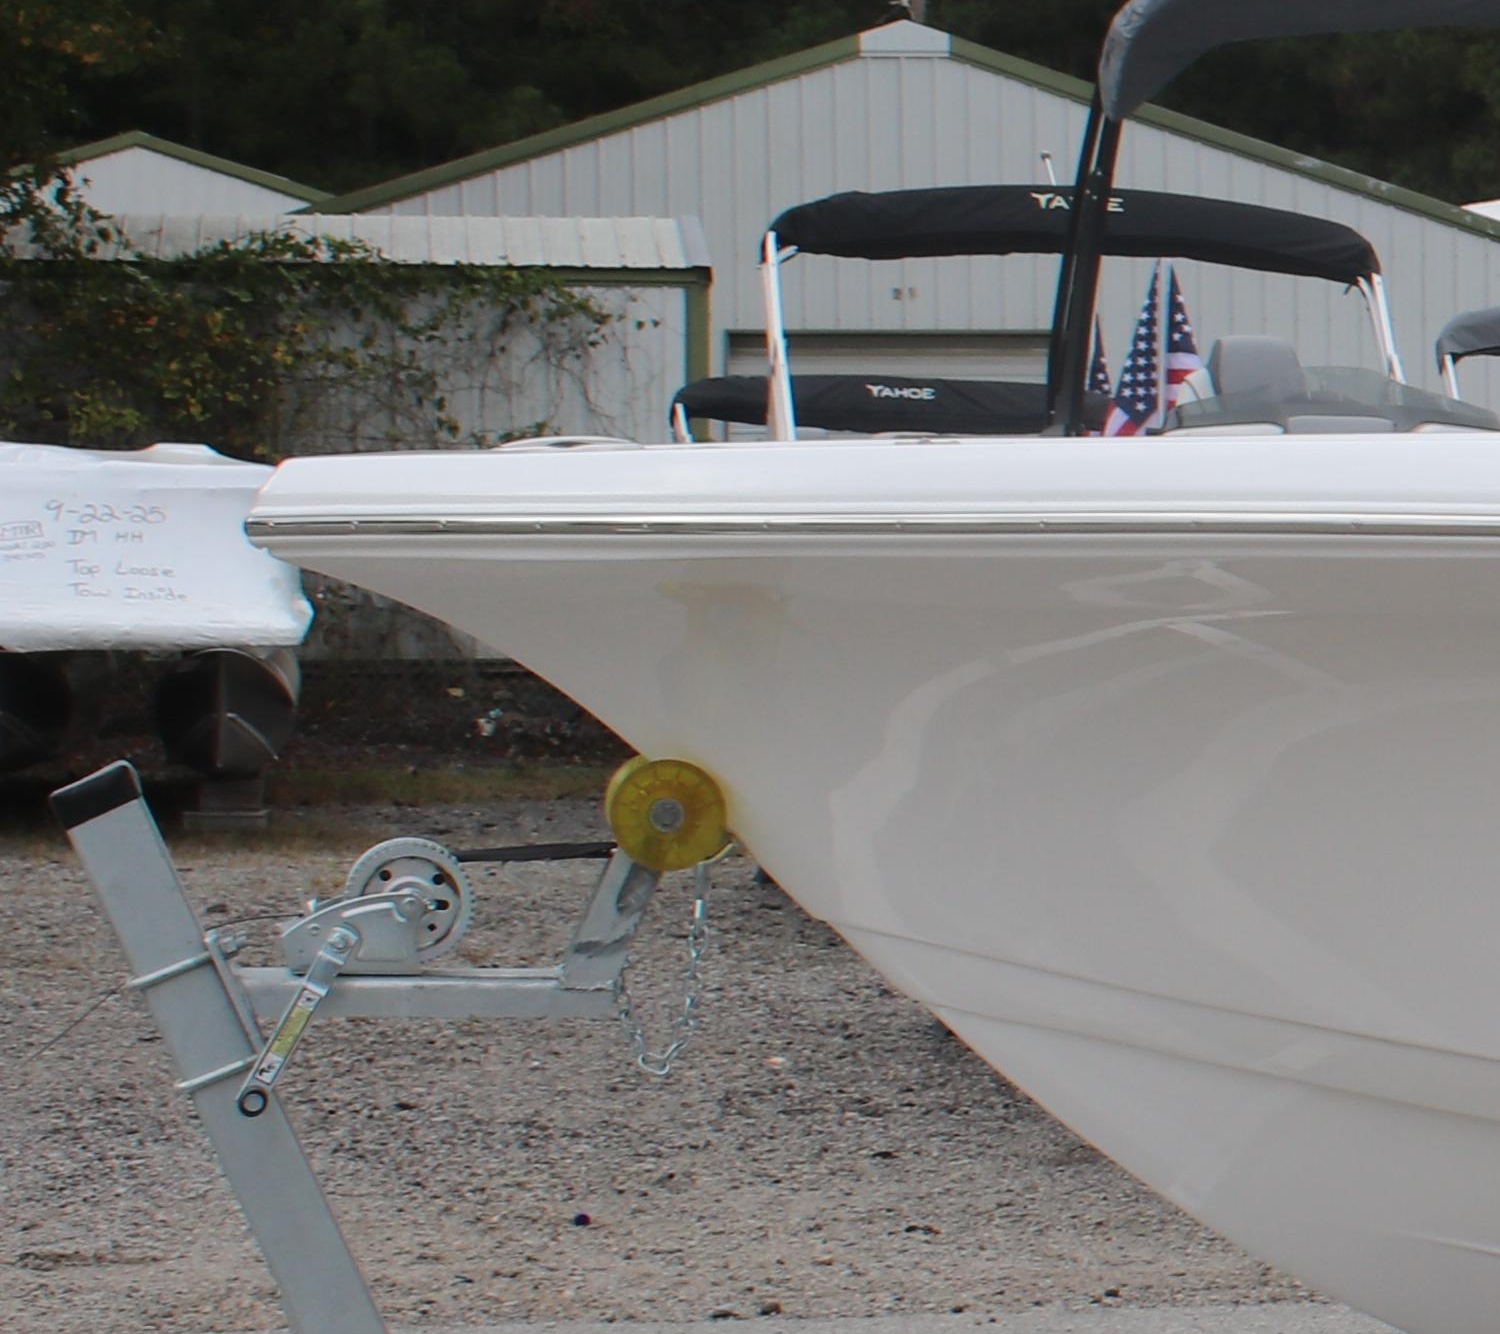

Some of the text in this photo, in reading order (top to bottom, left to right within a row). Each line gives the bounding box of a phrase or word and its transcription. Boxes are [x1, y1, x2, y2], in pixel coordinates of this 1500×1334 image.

[1029, 192, 1125, 212] TAE
[865, 383, 936, 400] TAHOE
[46, 499, 167, 524] 9-22-25
